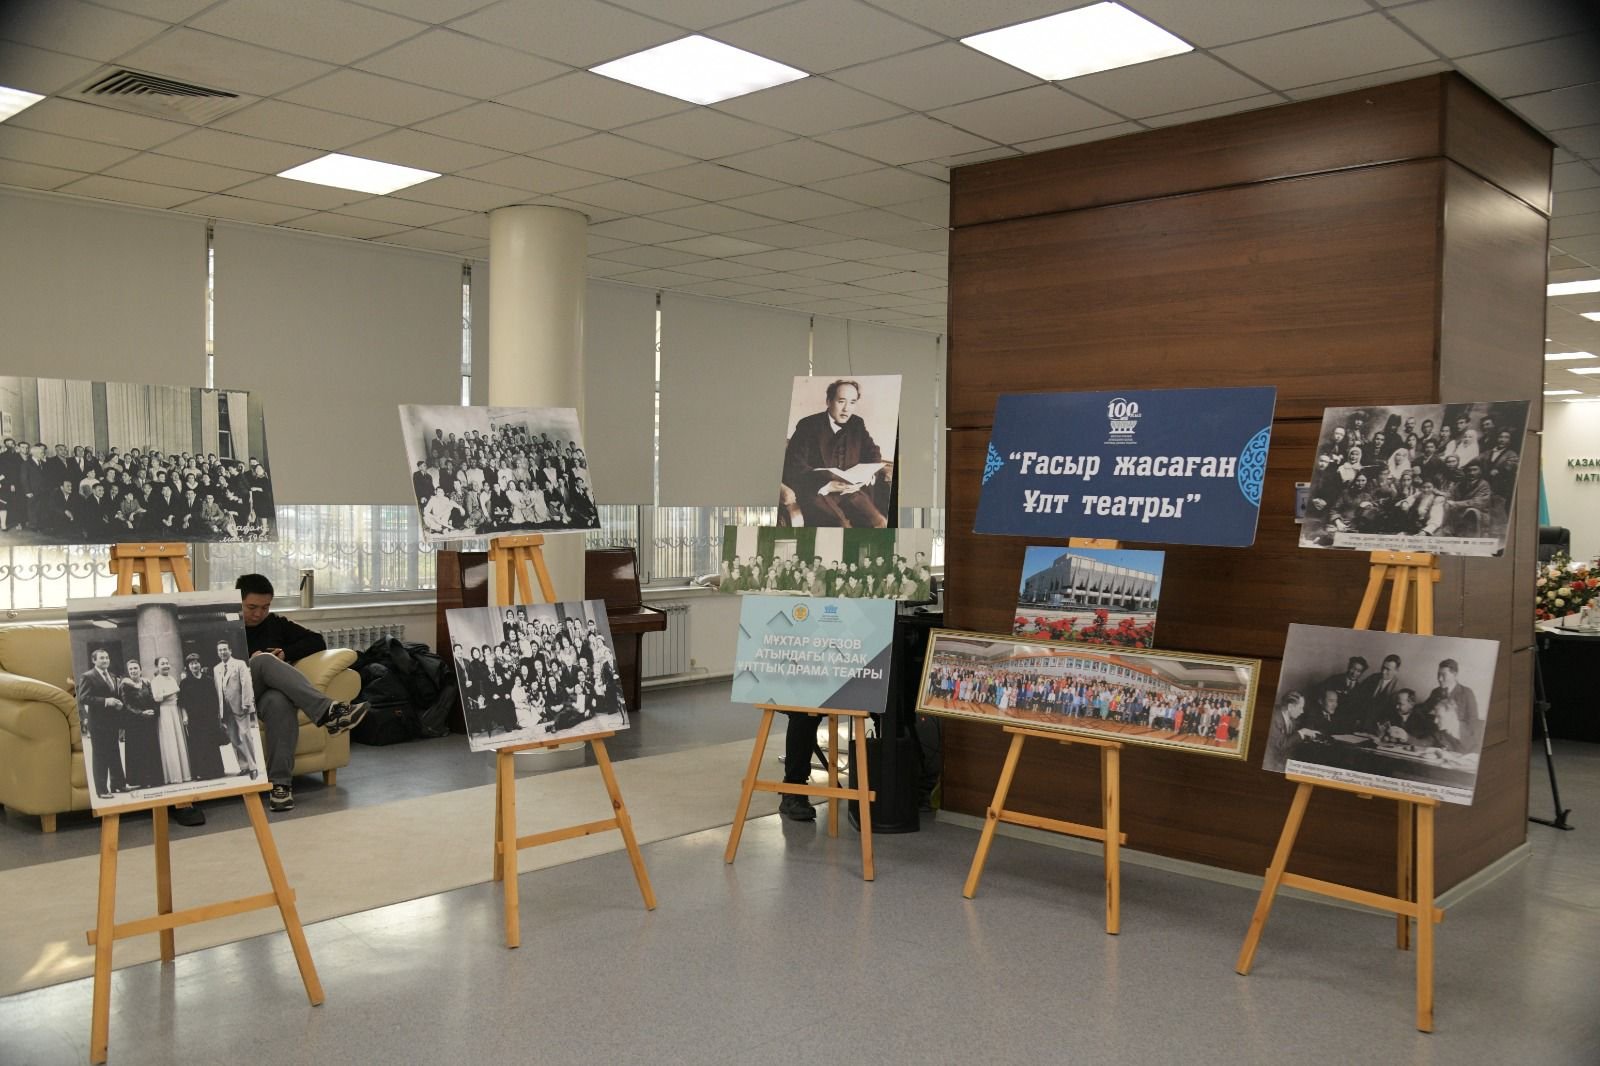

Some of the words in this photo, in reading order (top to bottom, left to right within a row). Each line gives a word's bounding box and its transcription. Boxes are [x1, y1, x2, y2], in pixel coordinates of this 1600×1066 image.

[1107, 401, 1139, 418] 100
[1009, 451, 1101, 481] “Ғасыр
[1113, 455, 1237, 478] жасаған
[1023, 489, 1070, 513] Ұлт
[1081, 493, 1201, 523] театры”
[763, 634, 810, 648] МҰХТАР
[813, 638, 862, 650] ӘУЕЗОВ
[755, 648, 825, 662] АТЫНДАҒЫ
[828, 653, 868, 666] ҚАЗАҚ
[788, 663, 829, 677] ДРАМА
[833, 666, 883, 680] ТЕАТРЫ
